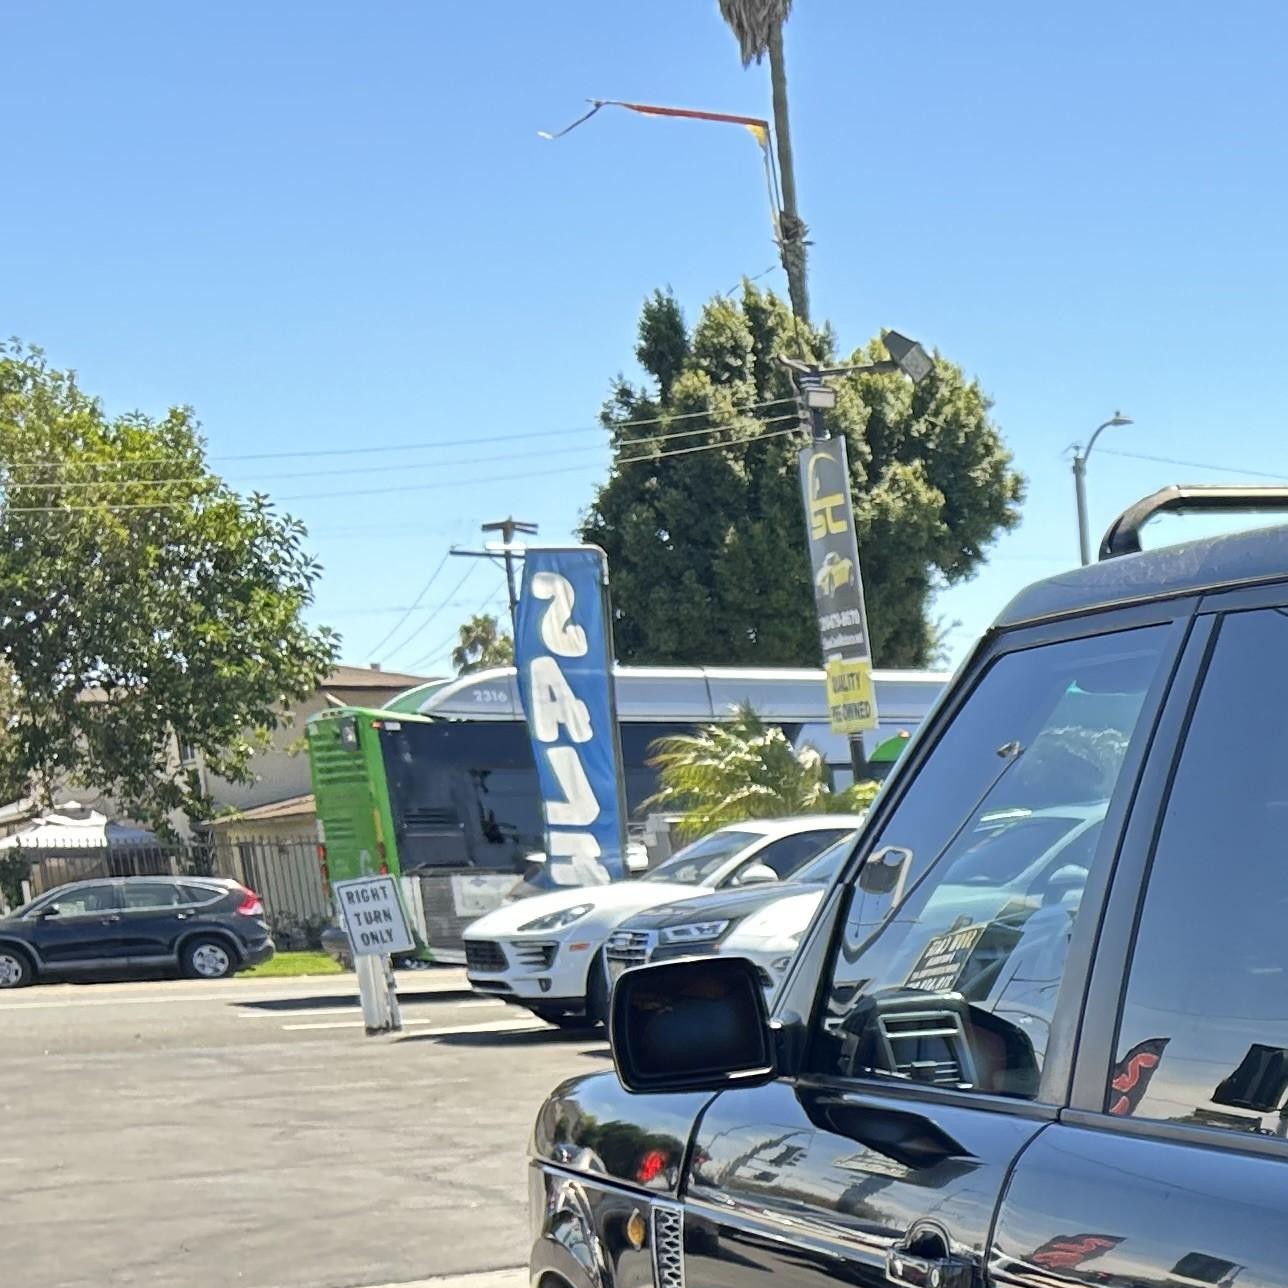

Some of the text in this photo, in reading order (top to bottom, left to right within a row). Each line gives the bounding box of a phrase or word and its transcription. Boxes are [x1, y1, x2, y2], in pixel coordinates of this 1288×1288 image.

[473, 689, 508, 702] 2316
[345, 886, 389, 904] RIGHT
[354, 907, 393, 927] TURN
[361, 928, 394, 946] ONLY
